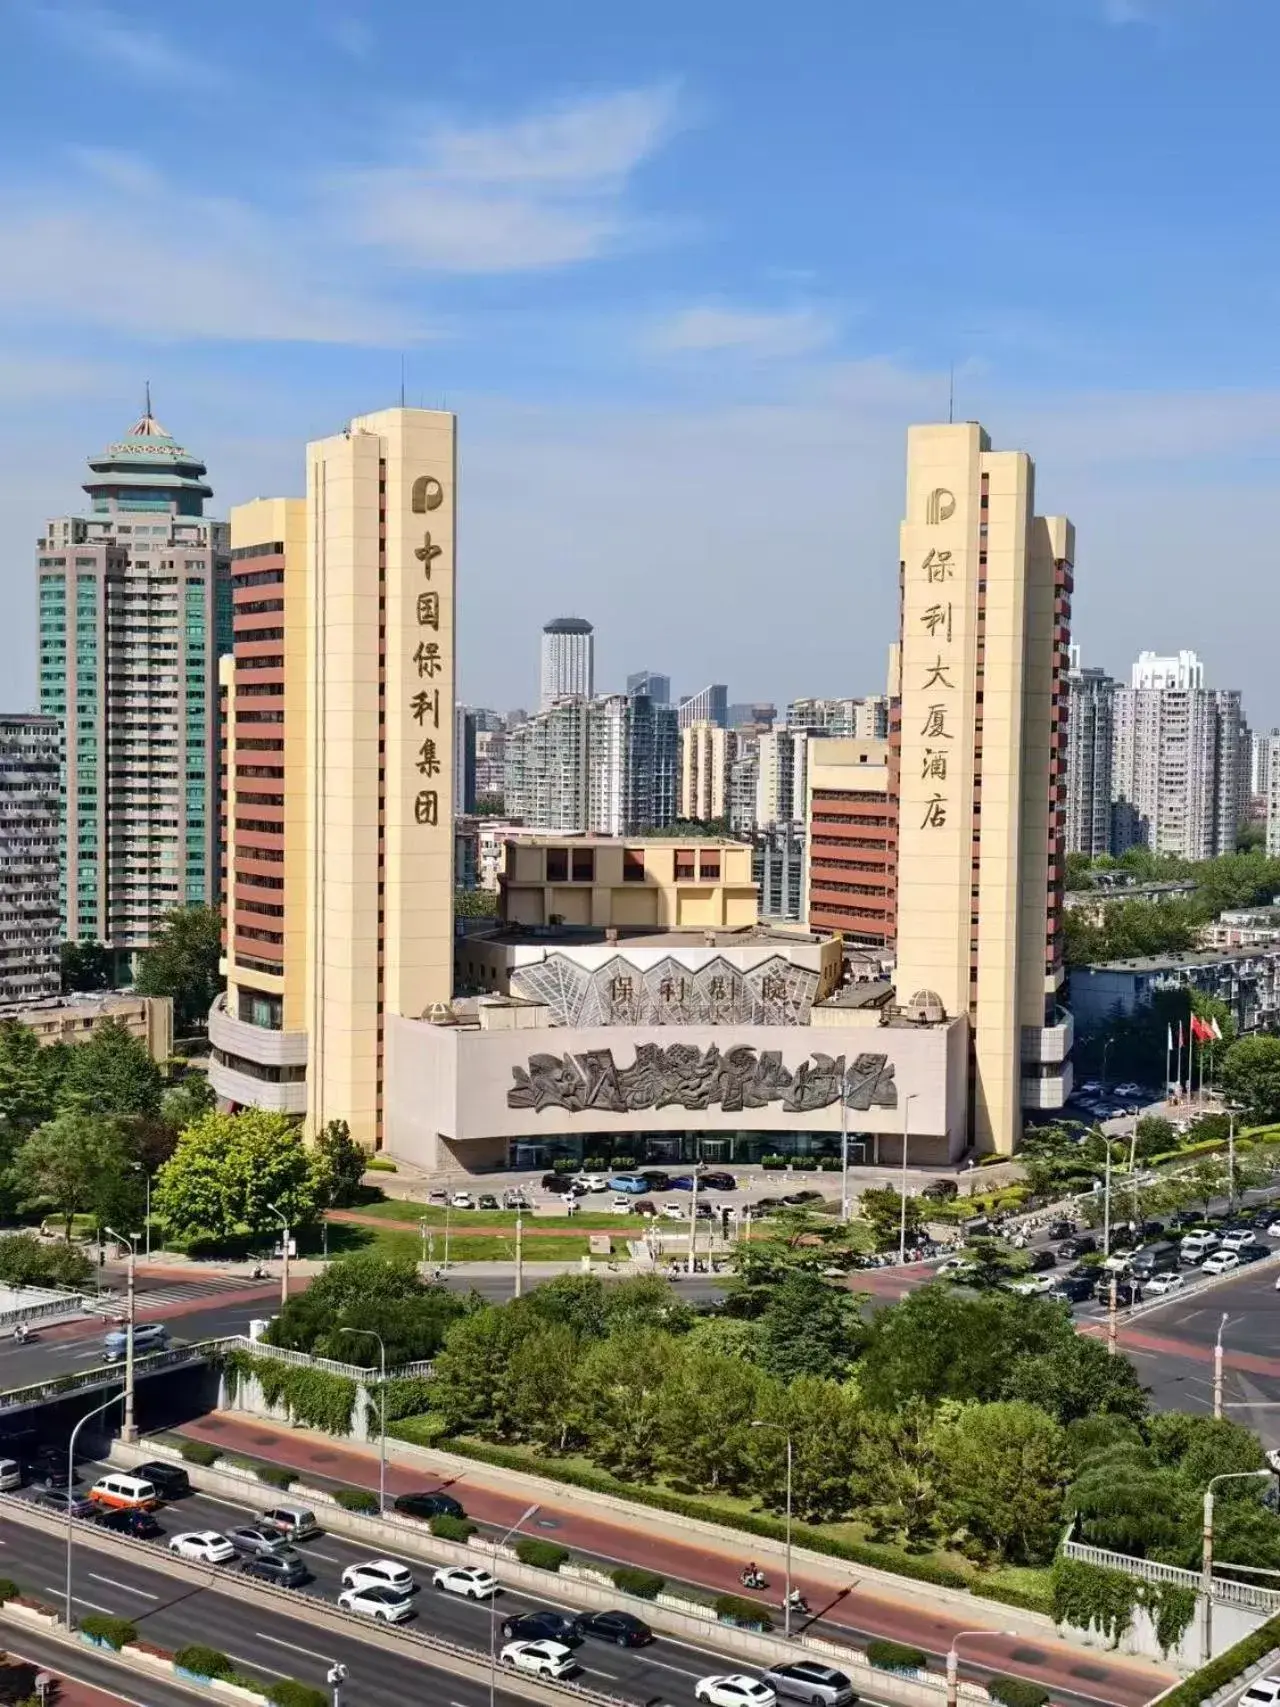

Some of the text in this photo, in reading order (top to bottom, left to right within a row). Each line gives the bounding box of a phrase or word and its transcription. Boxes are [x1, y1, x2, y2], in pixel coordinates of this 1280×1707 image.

[409, 531, 443, 827] 中国保利集团
[920, 547, 955, 830] 保利大厦酒店
